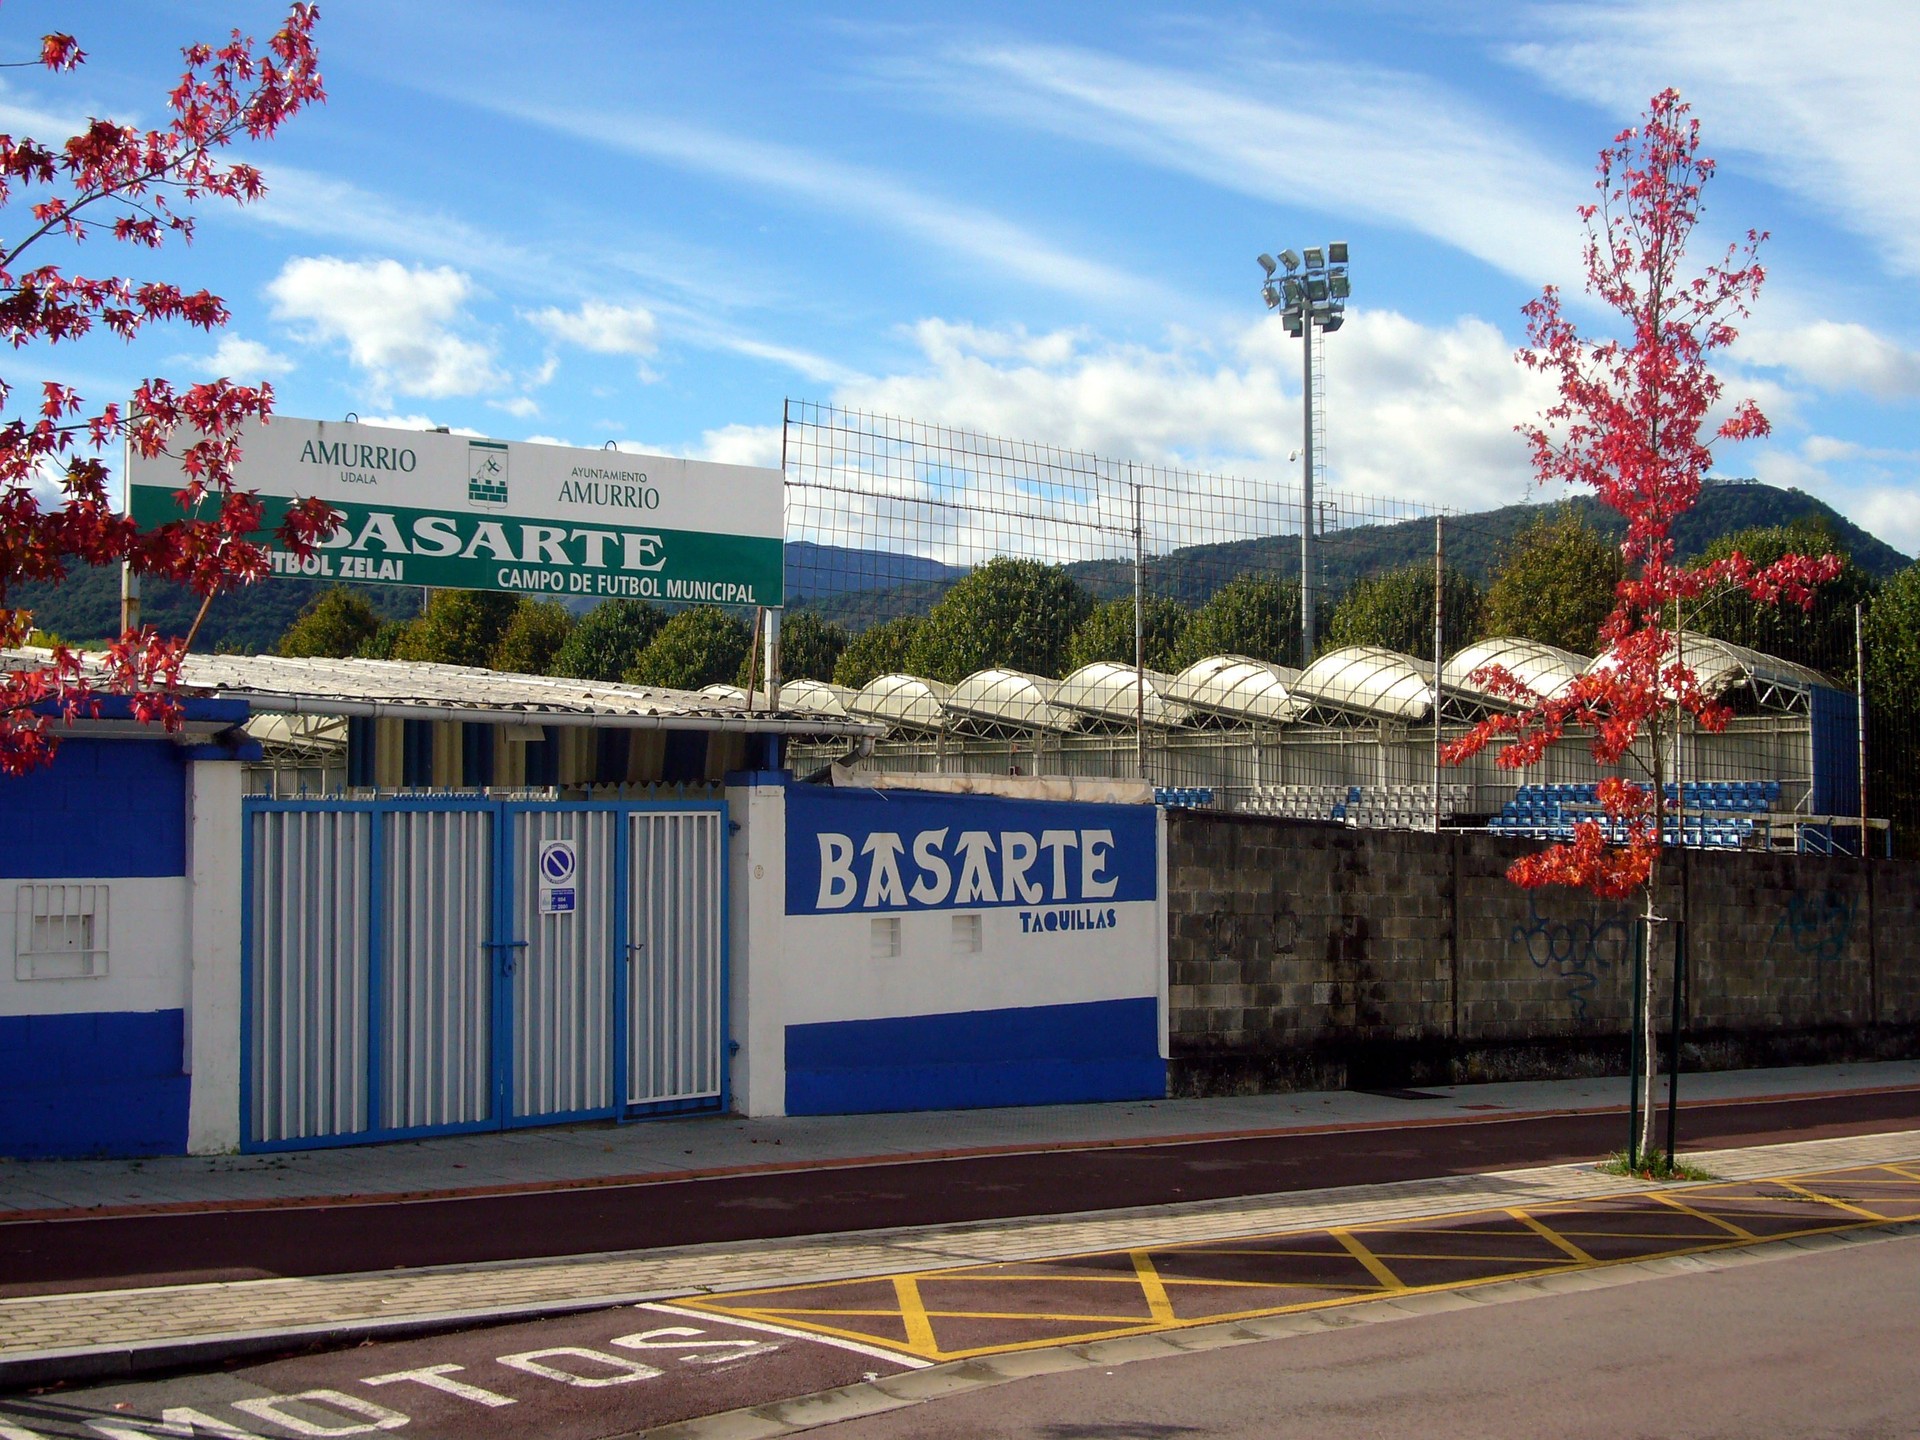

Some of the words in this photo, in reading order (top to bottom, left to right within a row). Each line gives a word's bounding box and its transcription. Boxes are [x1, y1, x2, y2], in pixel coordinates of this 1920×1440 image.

[300, 439, 417, 472] AMURRIO
[340, 471, 378, 485] UDALA
[571, 466, 648, 483] AYUNTAMIENTO
[558, 480, 660, 510] AMURRIO
[265, 551, 334, 576] TBOL
[339, 556, 404, 581] ZELAI
[497, 567, 565, 592] CAMPO
[569, 572, 592, 593] DE
[597, 574, 662, 598] FUTBOL
[666, 579, 756, 604] MUNICIPAL
[815, 826, 1120, 910] BASARTE
[1019, 908, 1117, 933] TAQUILLAS
